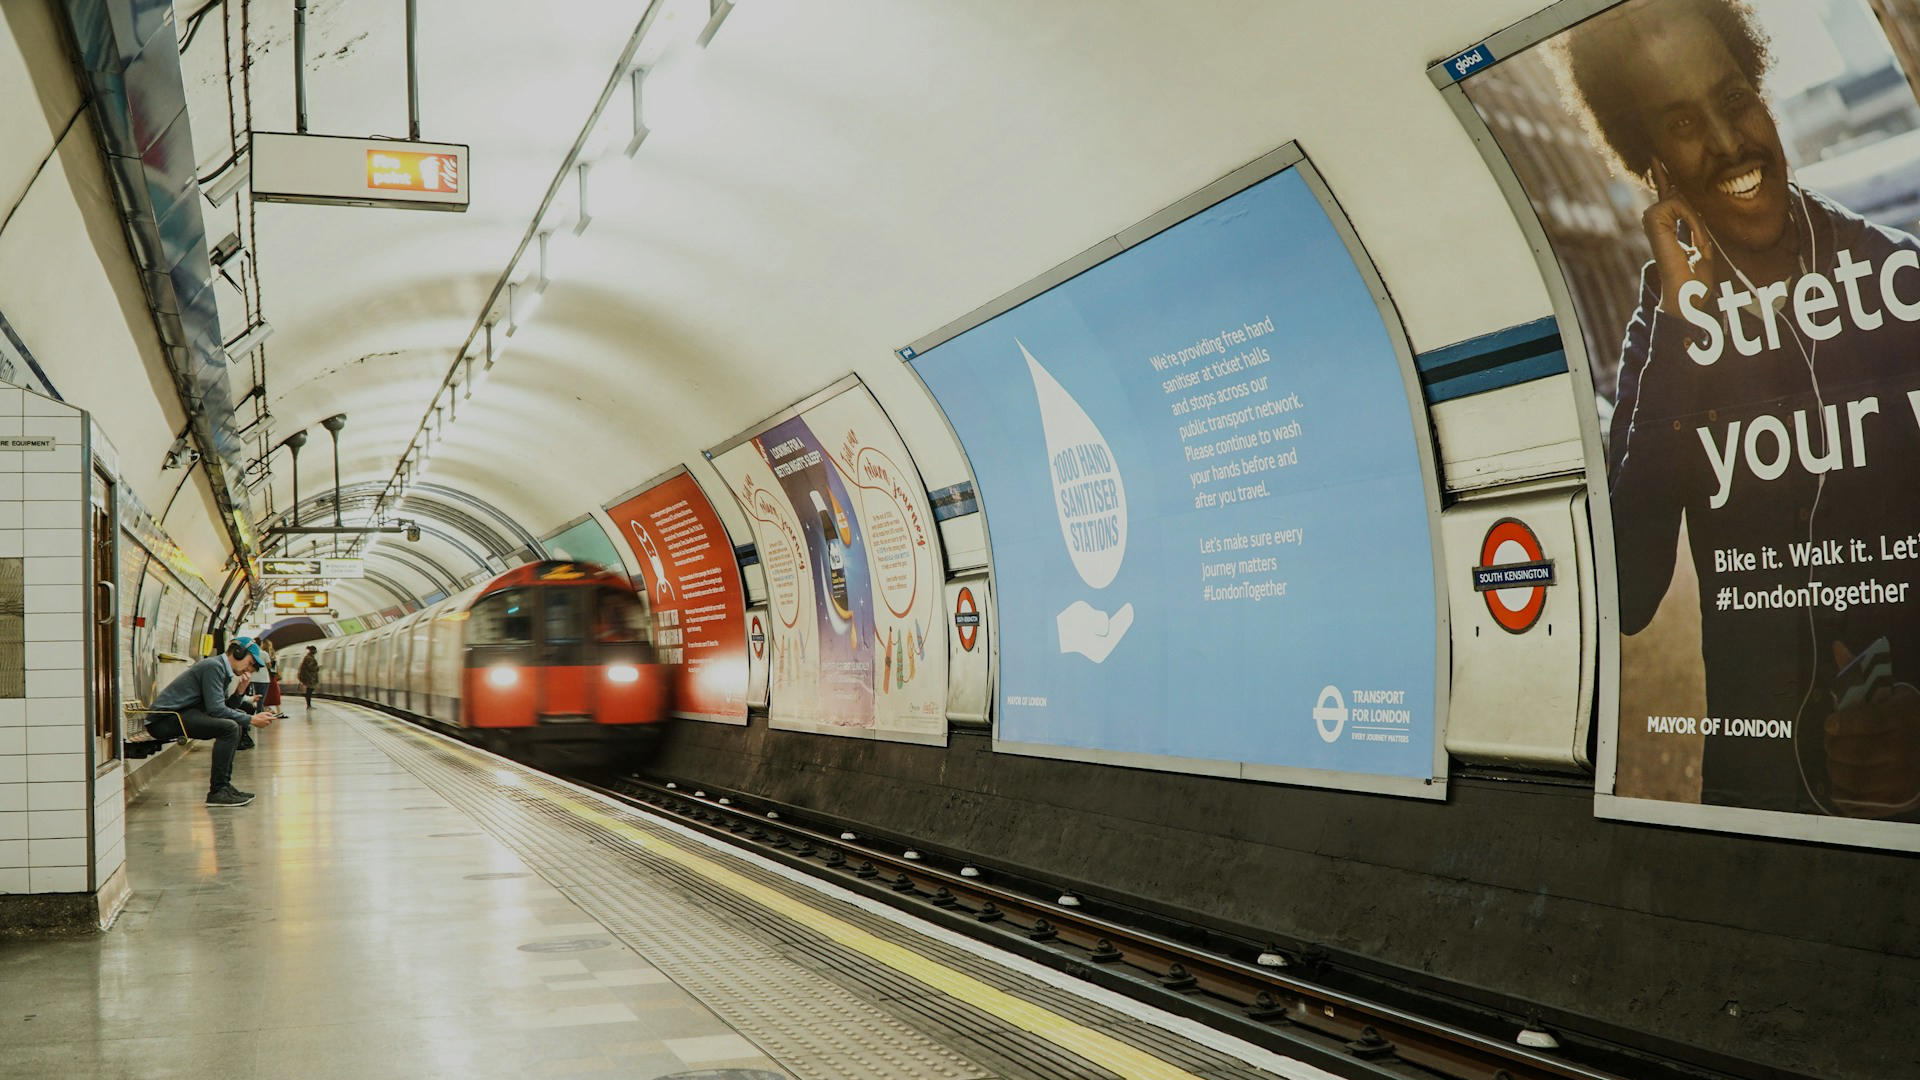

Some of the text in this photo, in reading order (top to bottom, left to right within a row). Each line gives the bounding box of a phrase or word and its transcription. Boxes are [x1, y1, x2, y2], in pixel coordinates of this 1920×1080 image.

[1456, 50, 1483, 75] global
[1678, 249, 1920, 366] Stretc
[1150, 315, 1275, 372] We're providing free hand
[1162, 347, 1270, 394] sanitiser at ticket halls
[1171, 375, 1269, 416] and stops across our
[1179, 391, 1304, 443] public transport network.
[1185, 420, 1302, 462] Please continue to wash
[1696, 397, 1880, 509] your
[1053, 443, 1112, 485] 1000 HAND
[1190, 446, 1298, 489] your hands before and
[1060, 478, 1119, 518] SANITISER
[1194, 479, 1271, 509] after you travel.
[1070, 514, 1119, 553] STATIONS
[1200, 527, 1303, 554] Let's make sure every
[1202, 557, 1277, 582] journey matters
[1714, 548, 1756, 573] Bike
[1762, 546, 1783, 570] it.
[1788, 539, 1844, 567] Walk
[1850, 538, 1873, 563] it.
[1203, 579, 1287, 602] #LondonTogether
[1480, 568, 1549, 583] SOUTH KENSINGTON
[1716, 578, 1909, 612] #LondonTogether
[1352, 690, 1405, 705] TRANSPORT
[1352, 708, 1410, 724] FOR LONDON
[1647, 715, 1792, 739] MAYOR OF LONDON
